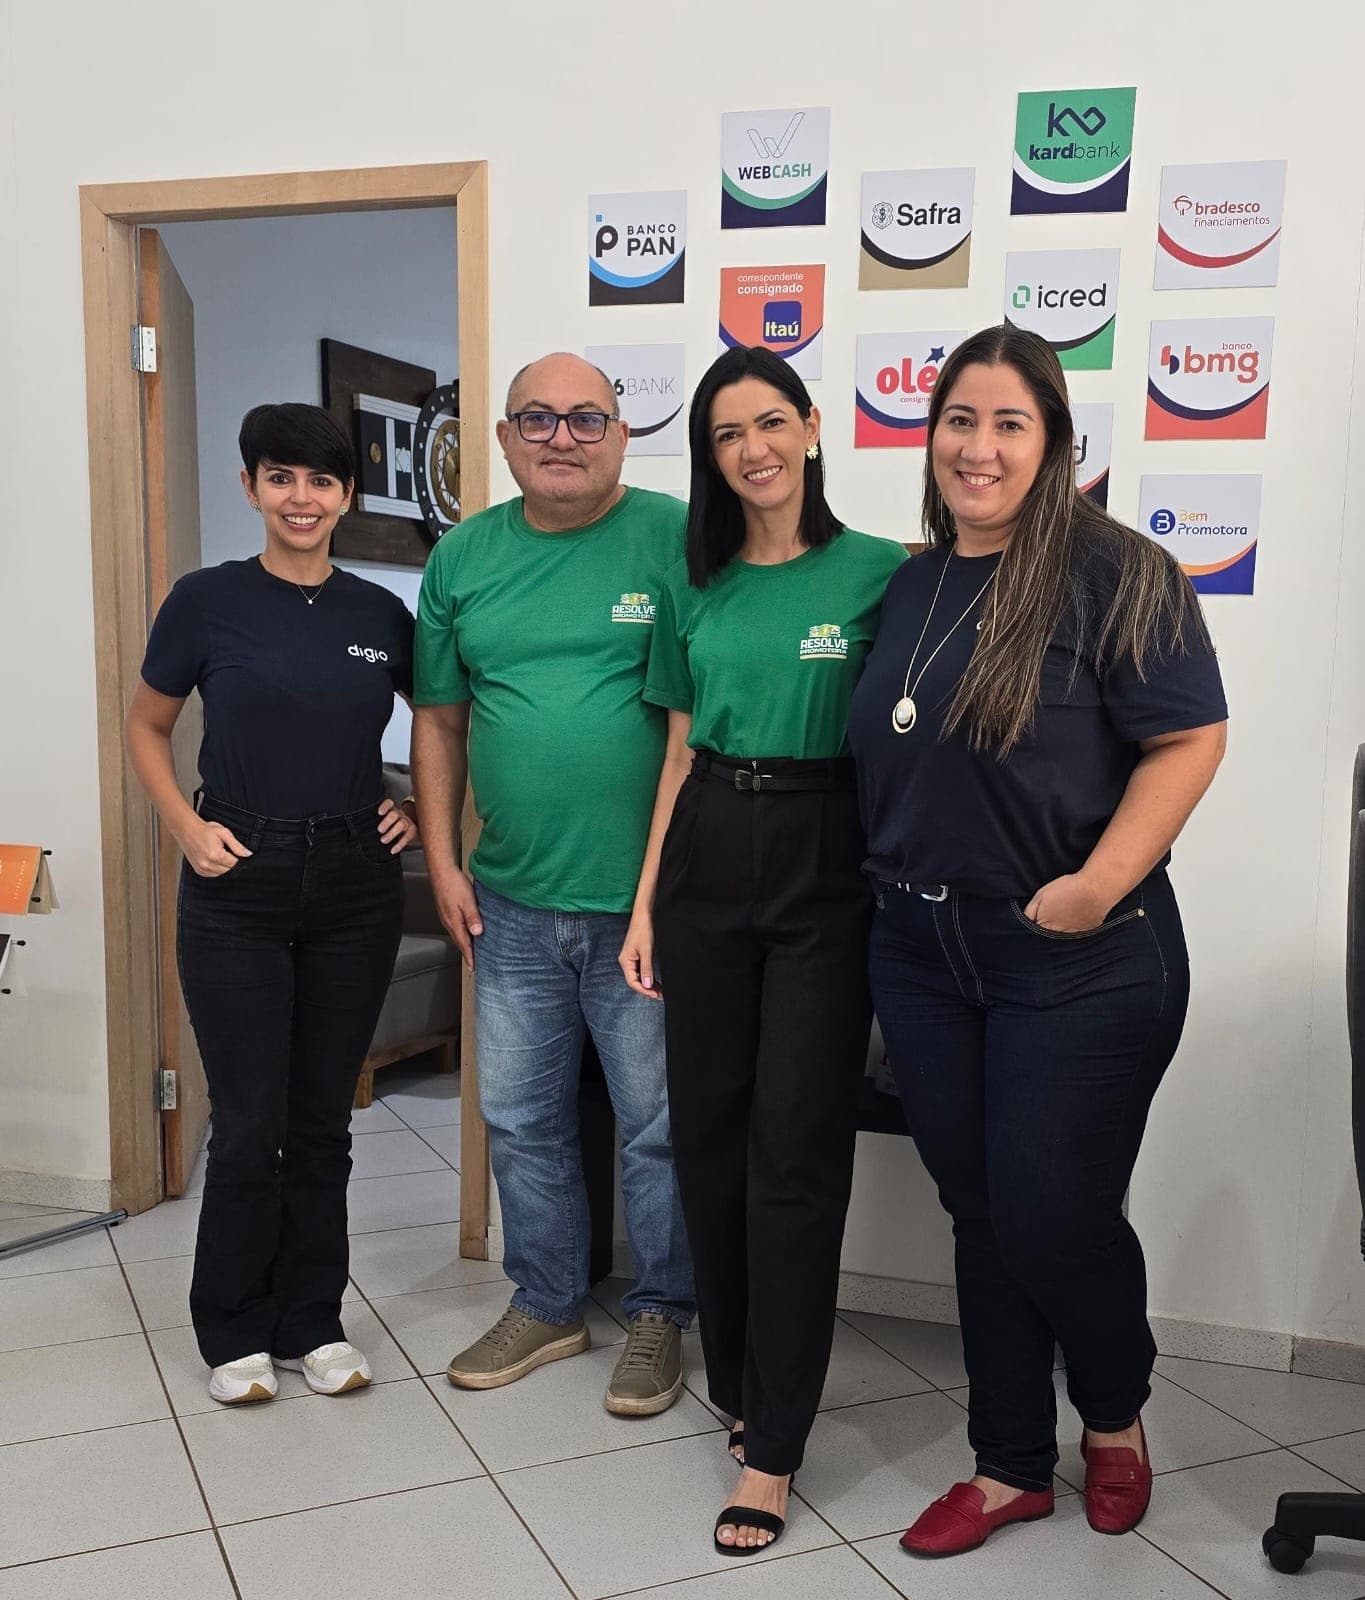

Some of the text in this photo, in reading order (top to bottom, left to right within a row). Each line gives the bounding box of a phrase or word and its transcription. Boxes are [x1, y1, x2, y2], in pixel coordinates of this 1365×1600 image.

[1029, 141, 1121, 160] kardbank
[738, 162, 812, 180] WEBCASH
[896, 202, 961, 226] Safra
[1195, 201, 1260, 215] bradesco
[1194, 216, 1270, 228] financiamentos
[627, 223, 676, 235] BANCO
[627, 236, 675, 256] PAN
[737, 272, 804, 283] correspondente
[737, 284, 804, 296] consignado
[1037, 283, 1107, 309] icred
[765, 321, 799, 337] Itaú
[1222, 342, 1252, 351] banco
[1183, 345, 1259, 384] bmg
[1178, 510, 1208, 521] Bem
[1178, 523, 1248, 535] Promotora
[612, 605, 656, 615] RESOLVE
[800, 637, 849, 650] RESOLVE
[347, 643, 389, 663] digio
